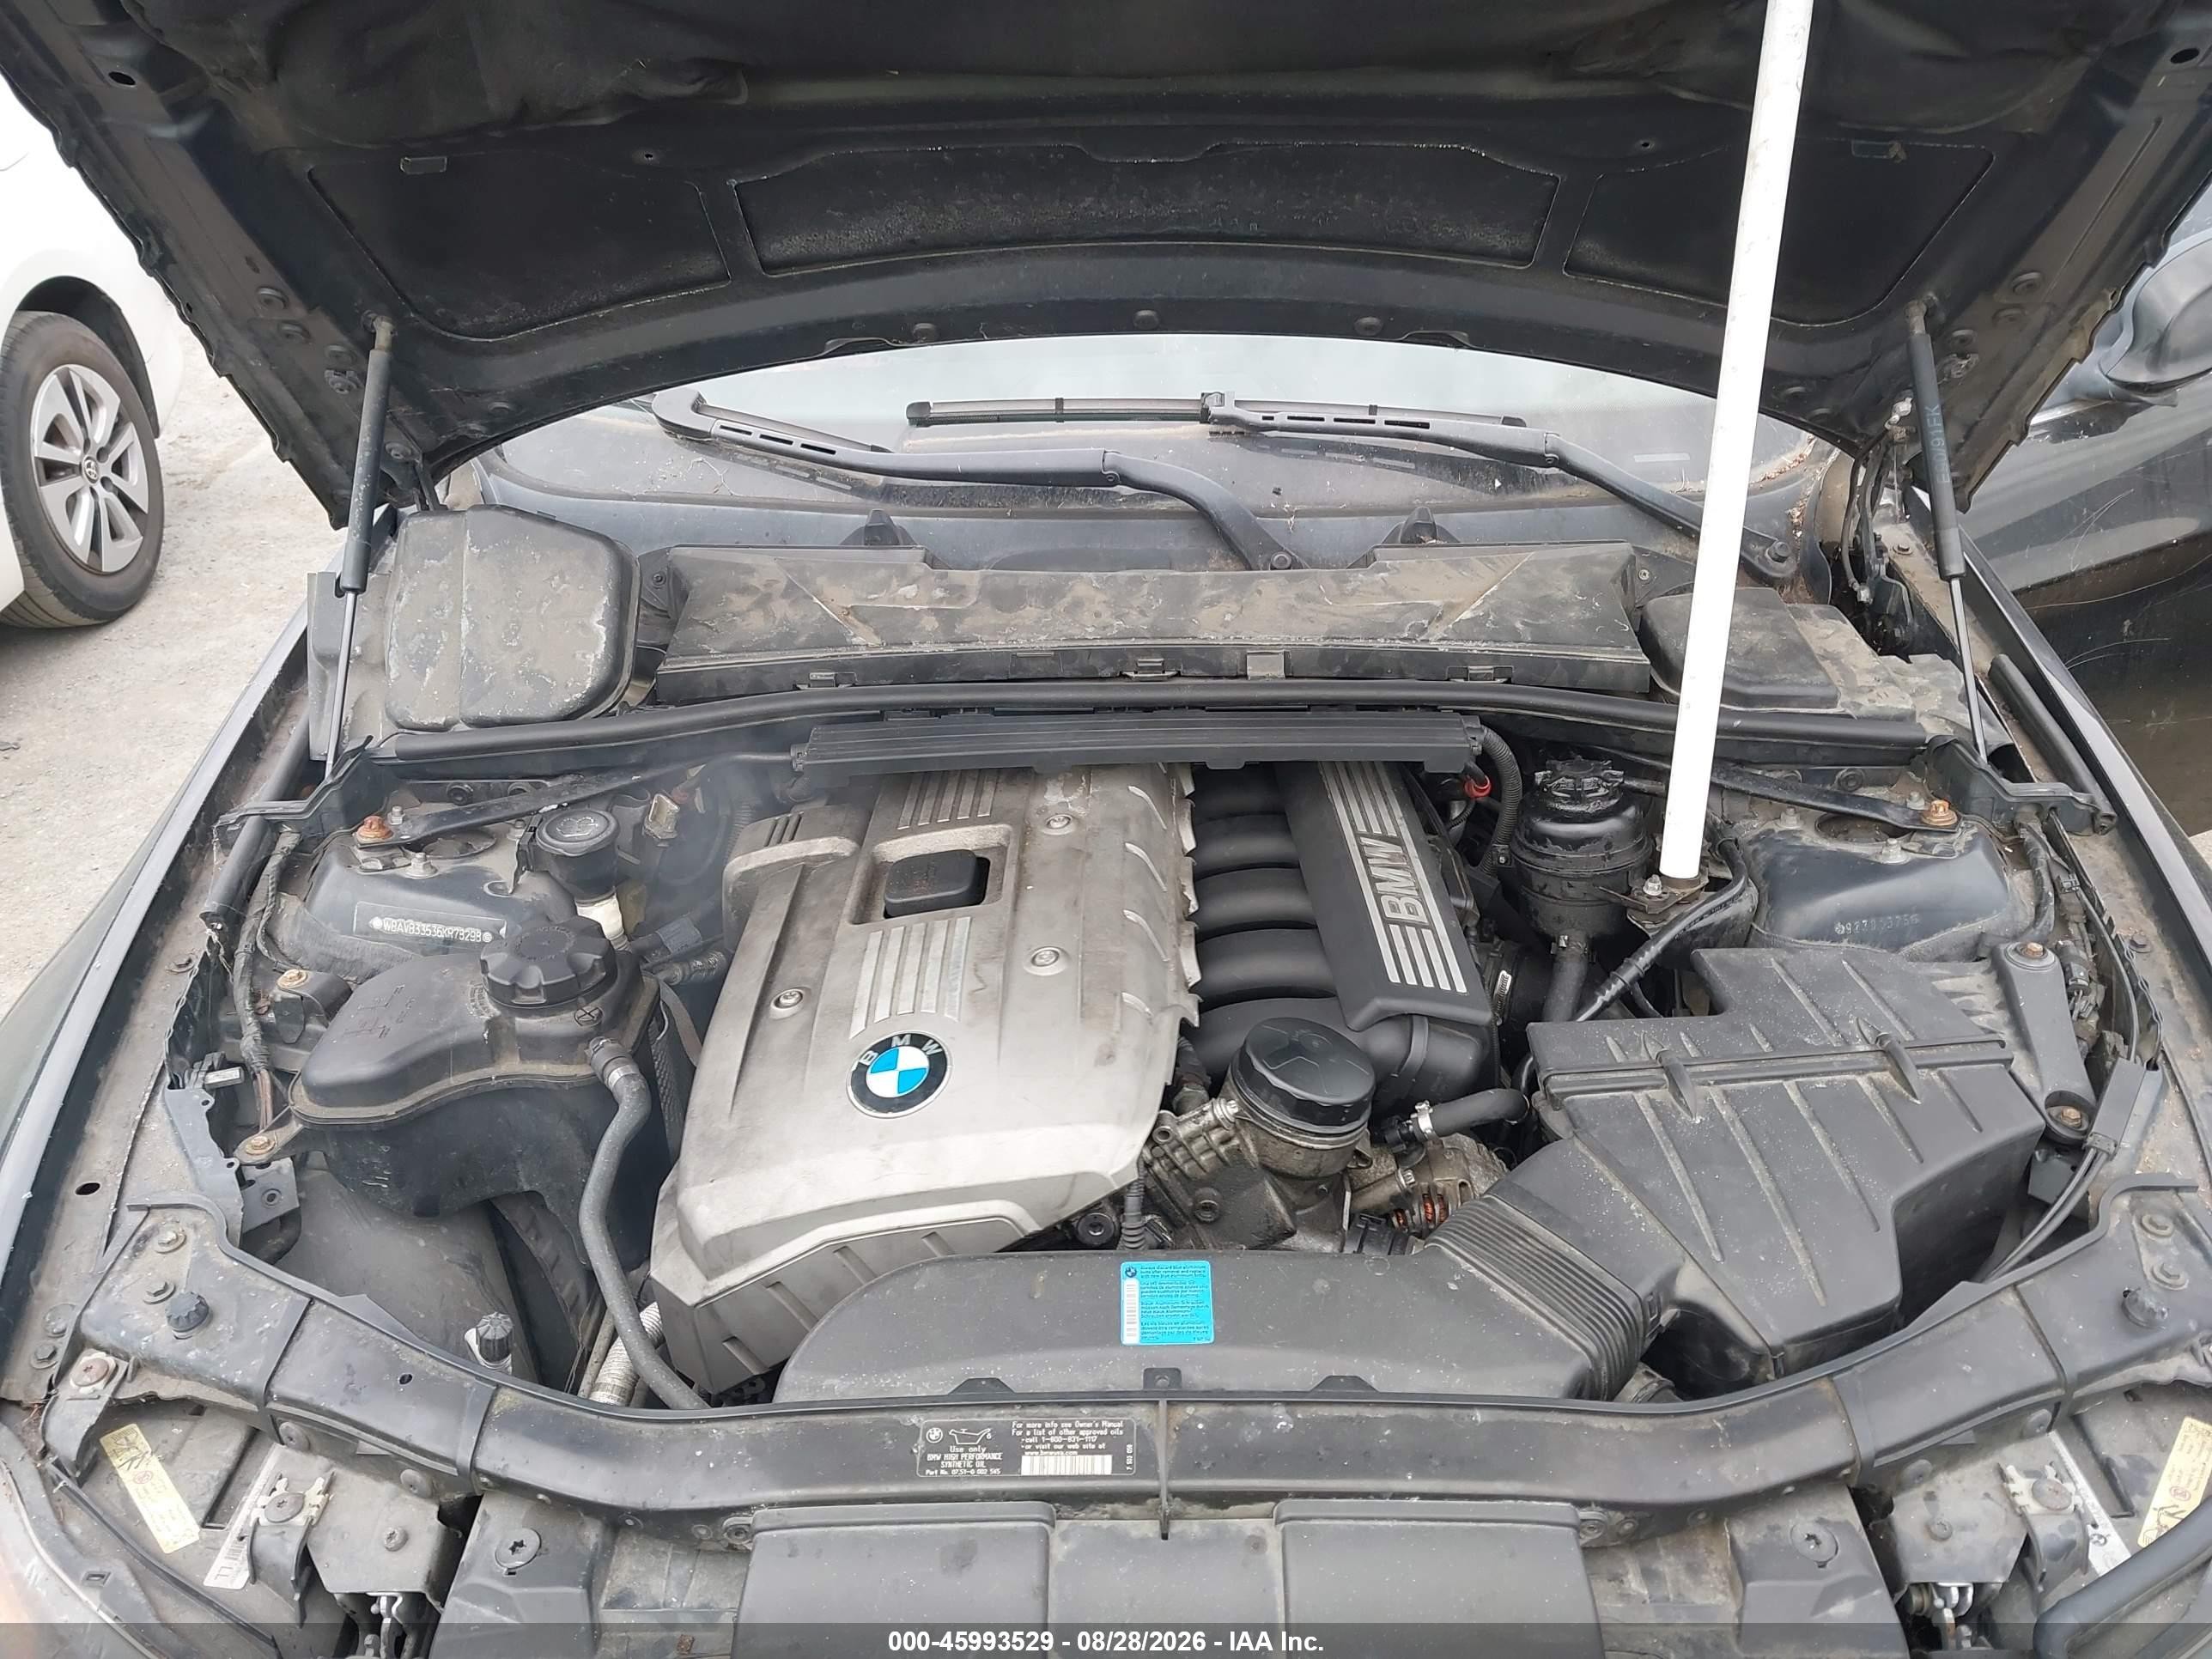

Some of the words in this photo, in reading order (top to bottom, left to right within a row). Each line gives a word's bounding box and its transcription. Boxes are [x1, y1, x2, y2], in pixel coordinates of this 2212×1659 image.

[1359, 836, 1429, 924] BMW
[859, 1033, 943, 1066] BMW
[960, 1452, 1003, 1461] PERFORMANCE
[968, 1445, 987, 1454] only
